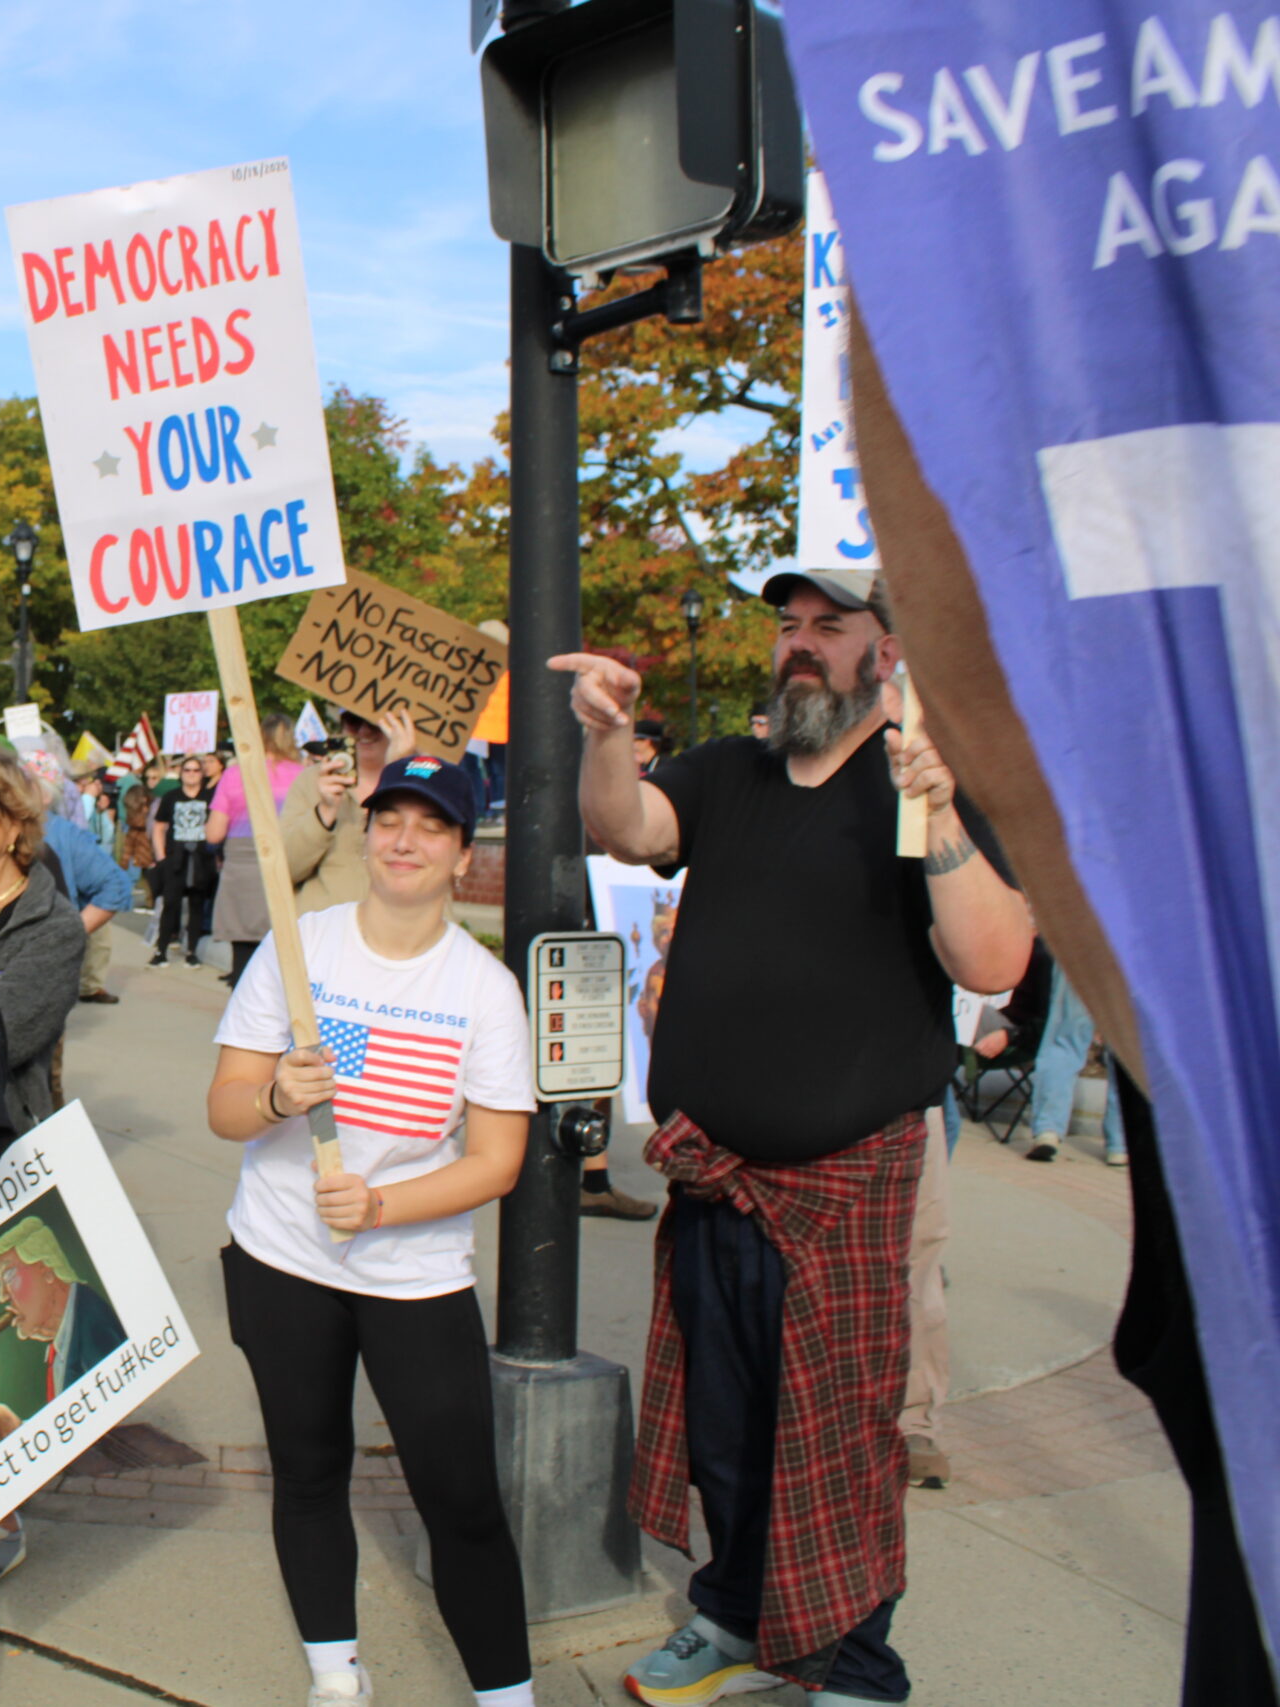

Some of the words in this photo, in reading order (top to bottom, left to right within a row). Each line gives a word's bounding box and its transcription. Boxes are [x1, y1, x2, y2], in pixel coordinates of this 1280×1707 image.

[858, 32, 1118, 162] SAVE
[22, 208, 281, 323] DEMOCRACY
[102, 309, 255, 400] NEEDS
[124, 406, 252, 496] YOUR
[89, 499, 315, 614] COURAGE
[374, 640, 480, 713] Tyrants
[386, 607, 503, 686] Fascists
[180, 715, 198, 731] LA
[322, 992, 360, 1010] USA
[364, 1001, 469, 1029] LACROSSE
[19, 1430, 52, 1463] to
[53, 1389, 98, 1444] get
[95, 1316, 181, 1403] fu#ked
